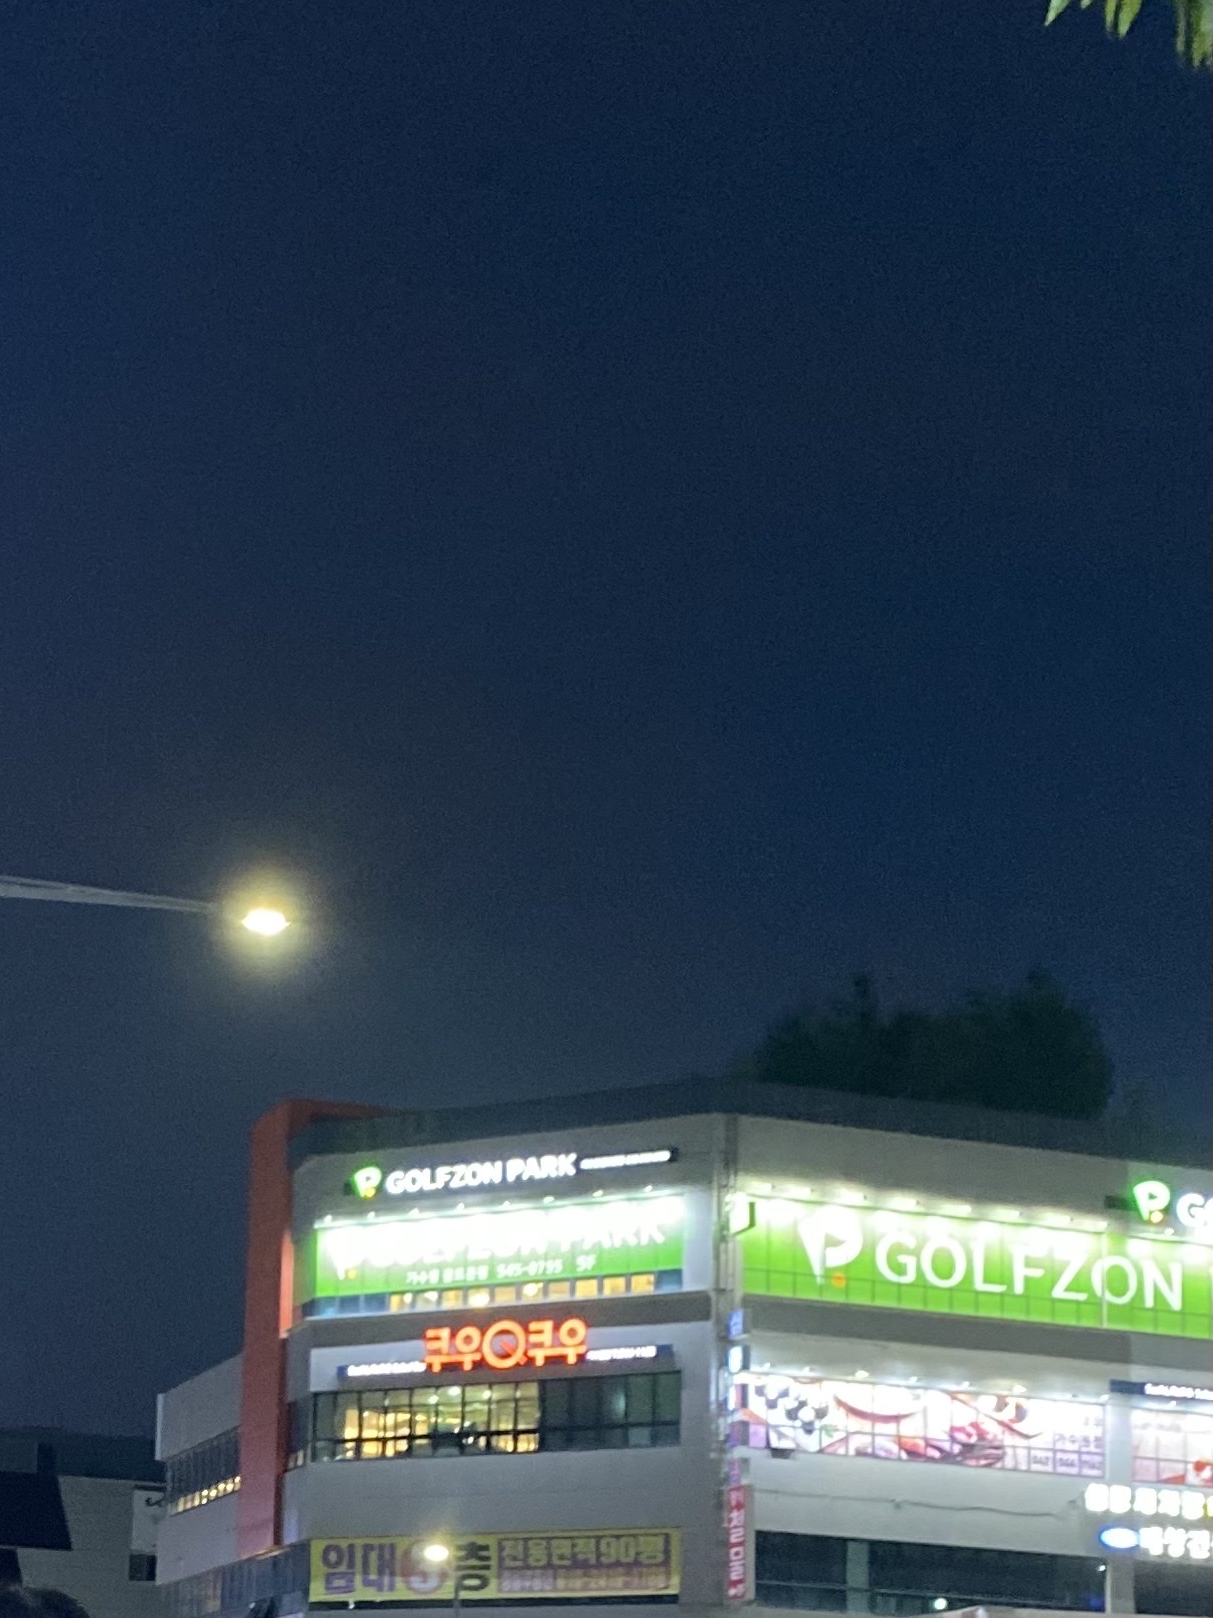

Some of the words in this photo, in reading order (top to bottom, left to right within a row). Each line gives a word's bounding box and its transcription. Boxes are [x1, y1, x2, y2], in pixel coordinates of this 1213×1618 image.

[386, 1160, 503, 1194] GOLFZON
[507, 1153, 577, 1182] PARK
[1176, 1193, 1213, 1228] G
[875, 1228, 1183, 1311] GOLFZON
[321, 1542, 397, 1594] 임대
